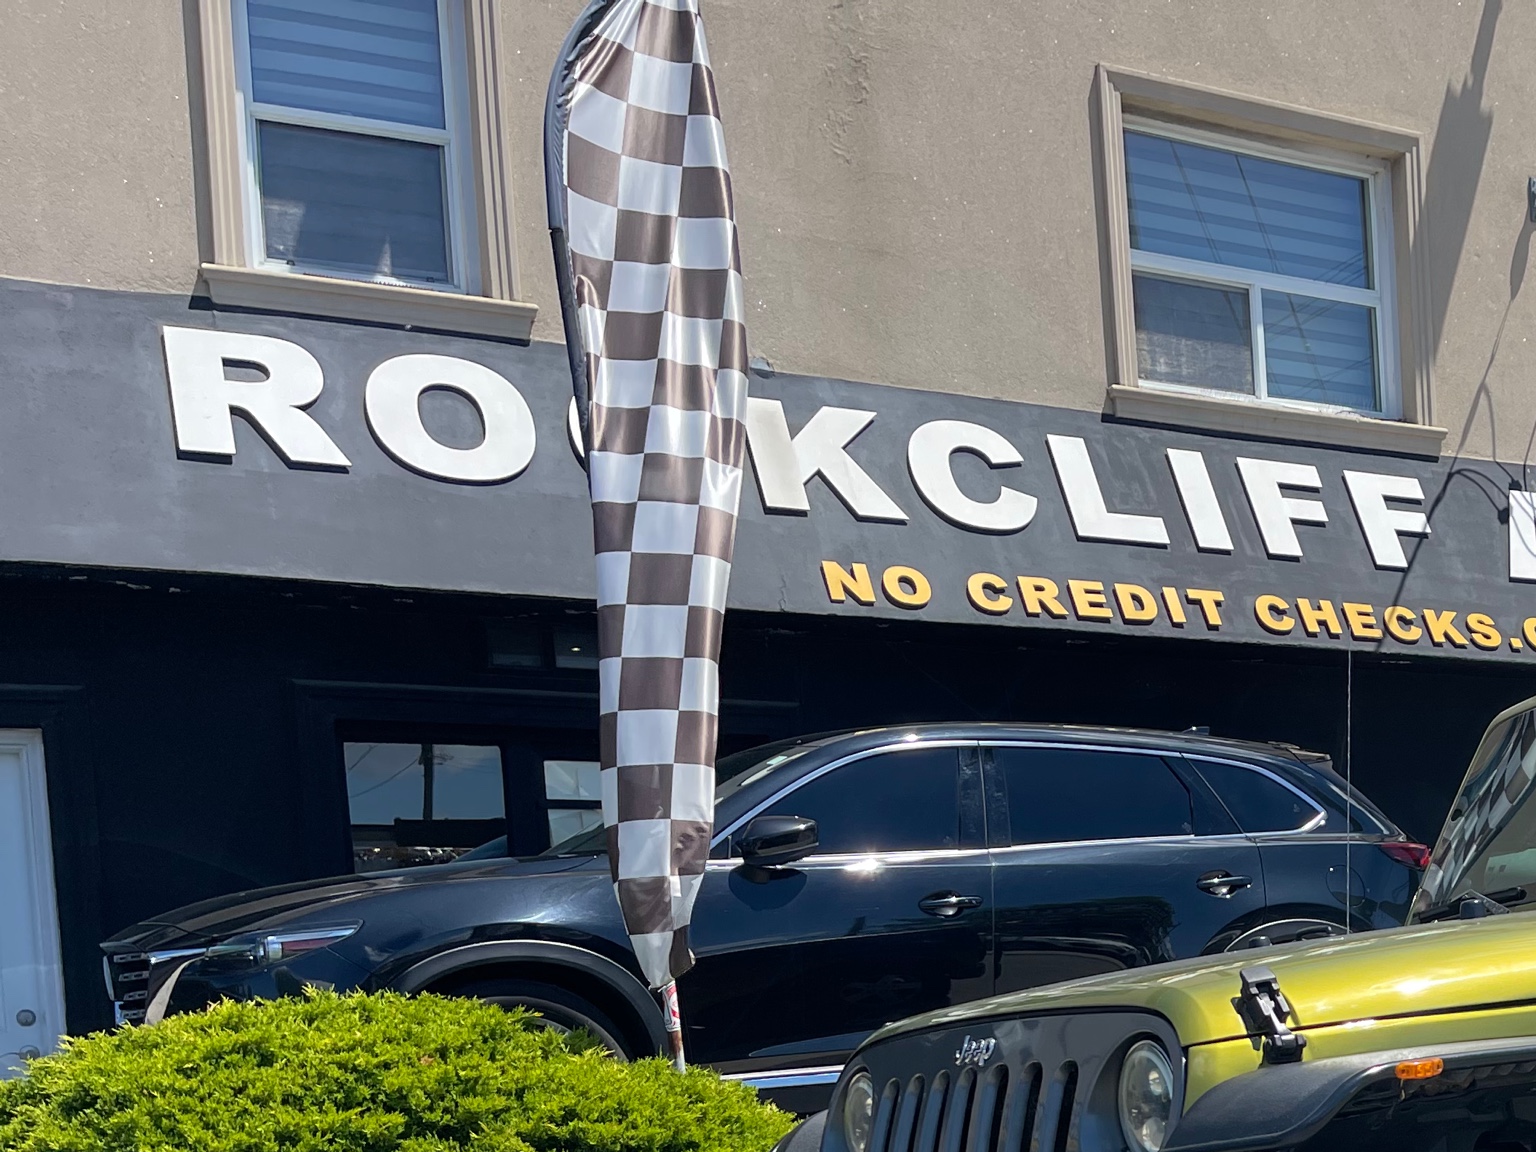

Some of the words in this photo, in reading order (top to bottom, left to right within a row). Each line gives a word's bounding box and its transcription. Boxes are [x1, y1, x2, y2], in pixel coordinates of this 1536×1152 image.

[161, 325, 1432, 570] ROKCLIFF
[820, 560, 934, 611] NO
[965, 571, 1226, 629] CREDIT
[955, 1034, 997, 1067] Jeep
